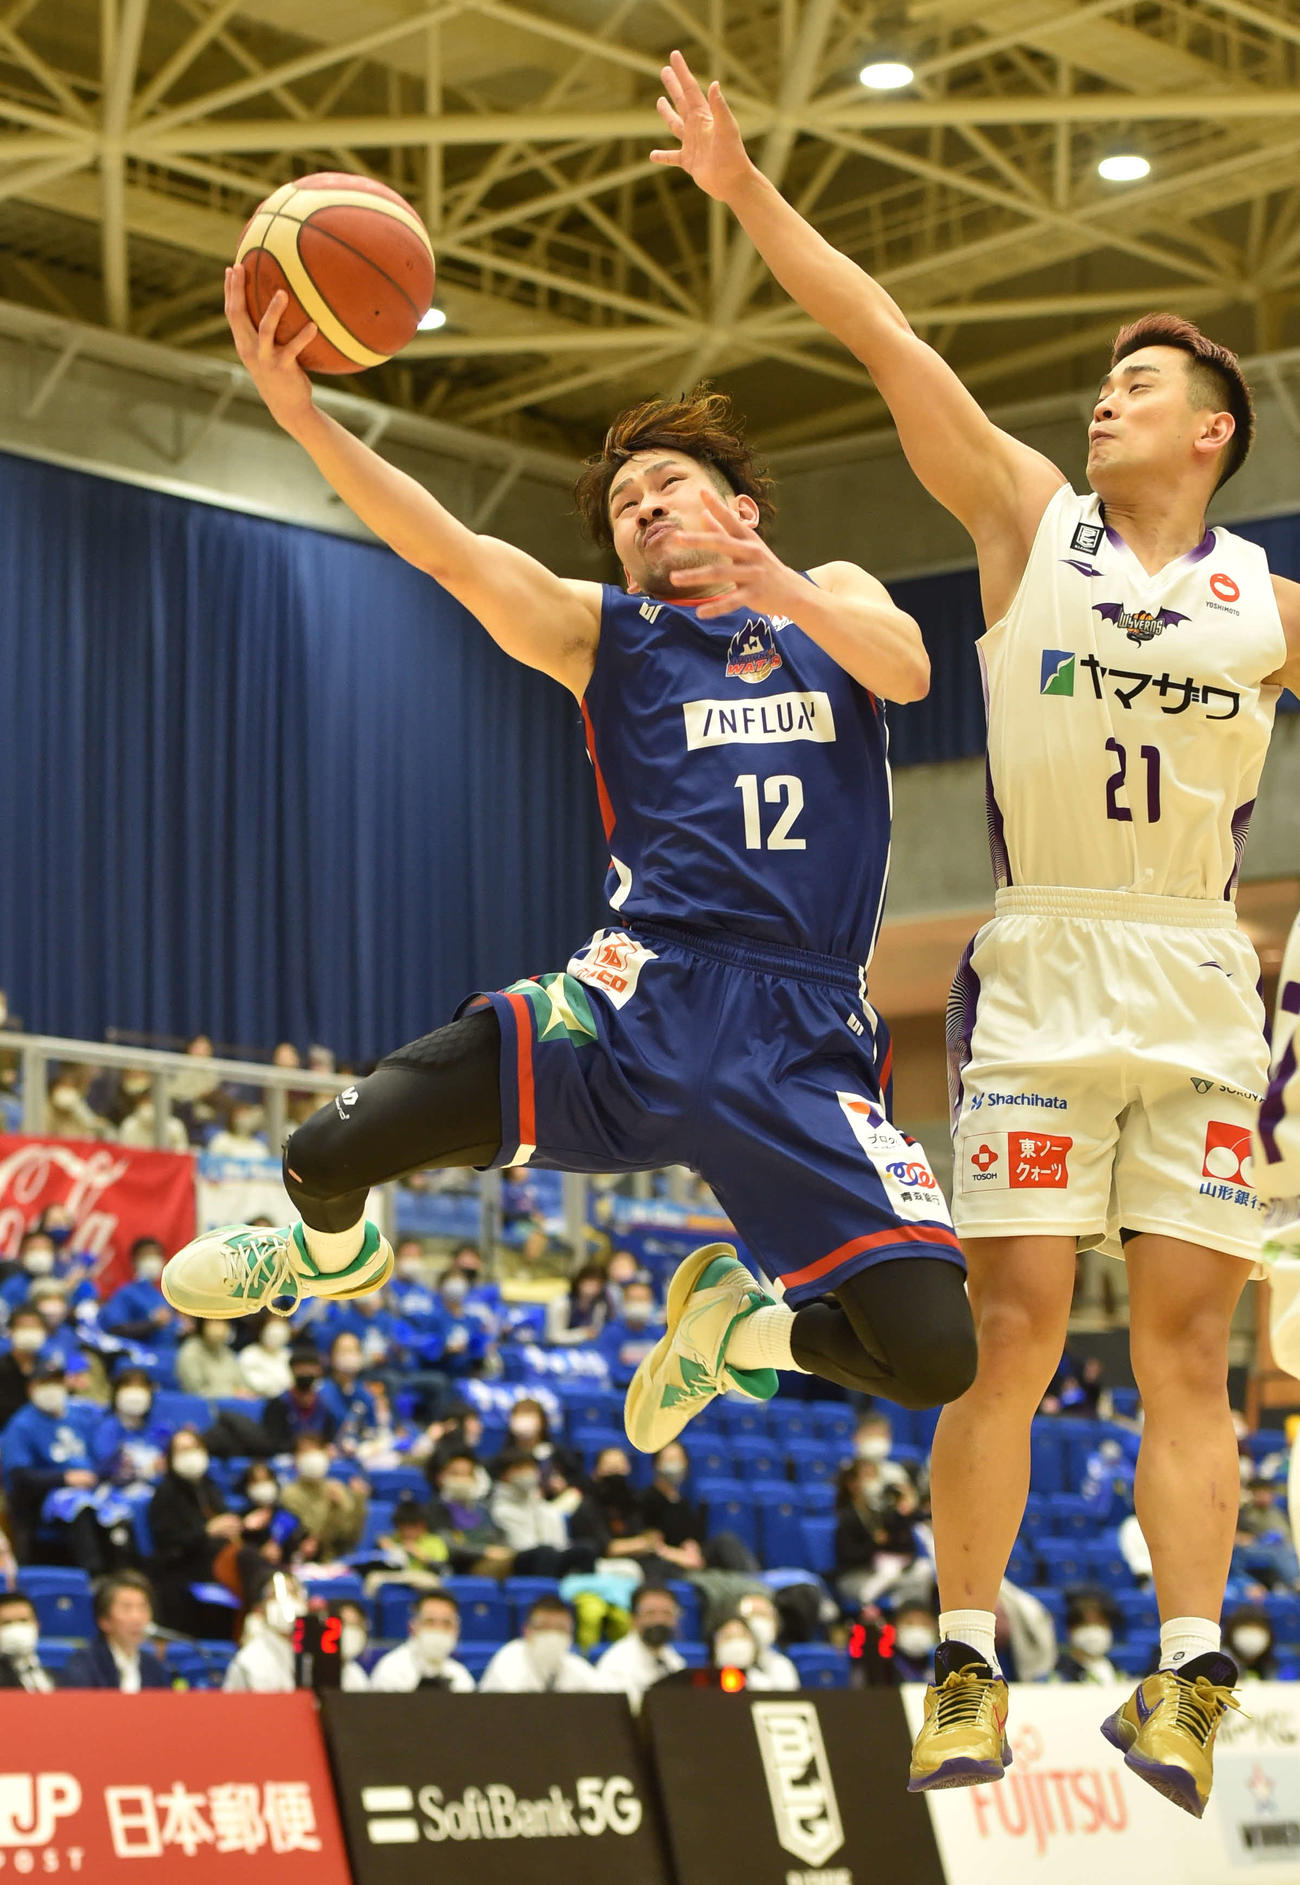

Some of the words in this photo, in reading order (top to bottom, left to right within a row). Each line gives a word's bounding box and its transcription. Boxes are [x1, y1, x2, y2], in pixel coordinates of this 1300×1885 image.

[1206, 601, 1240, 617] YOSHIMOTO
[1080, 654, 1240, 720] ヤマザワ
[703, 701, 815, 737] INFLUX
[1105, 737, 1161, 823] 21
[734, 774, 807, 850] 12
[987, 1092, 1068, 1110] Shachihata
[1016, 1162, 1063, 1182] クォーツ
[1018, 1138, 1063, 1159] 東ソー
[972, 1173, 998, 1181] TOSOH
[104, 1782, 322, 1858] 日本郵便
[417, 1784, 582, 1842] SoftBank
[575, 1776, 642, 1836] 5G
[969, 1767, 1129, 1858] FUJITSU
